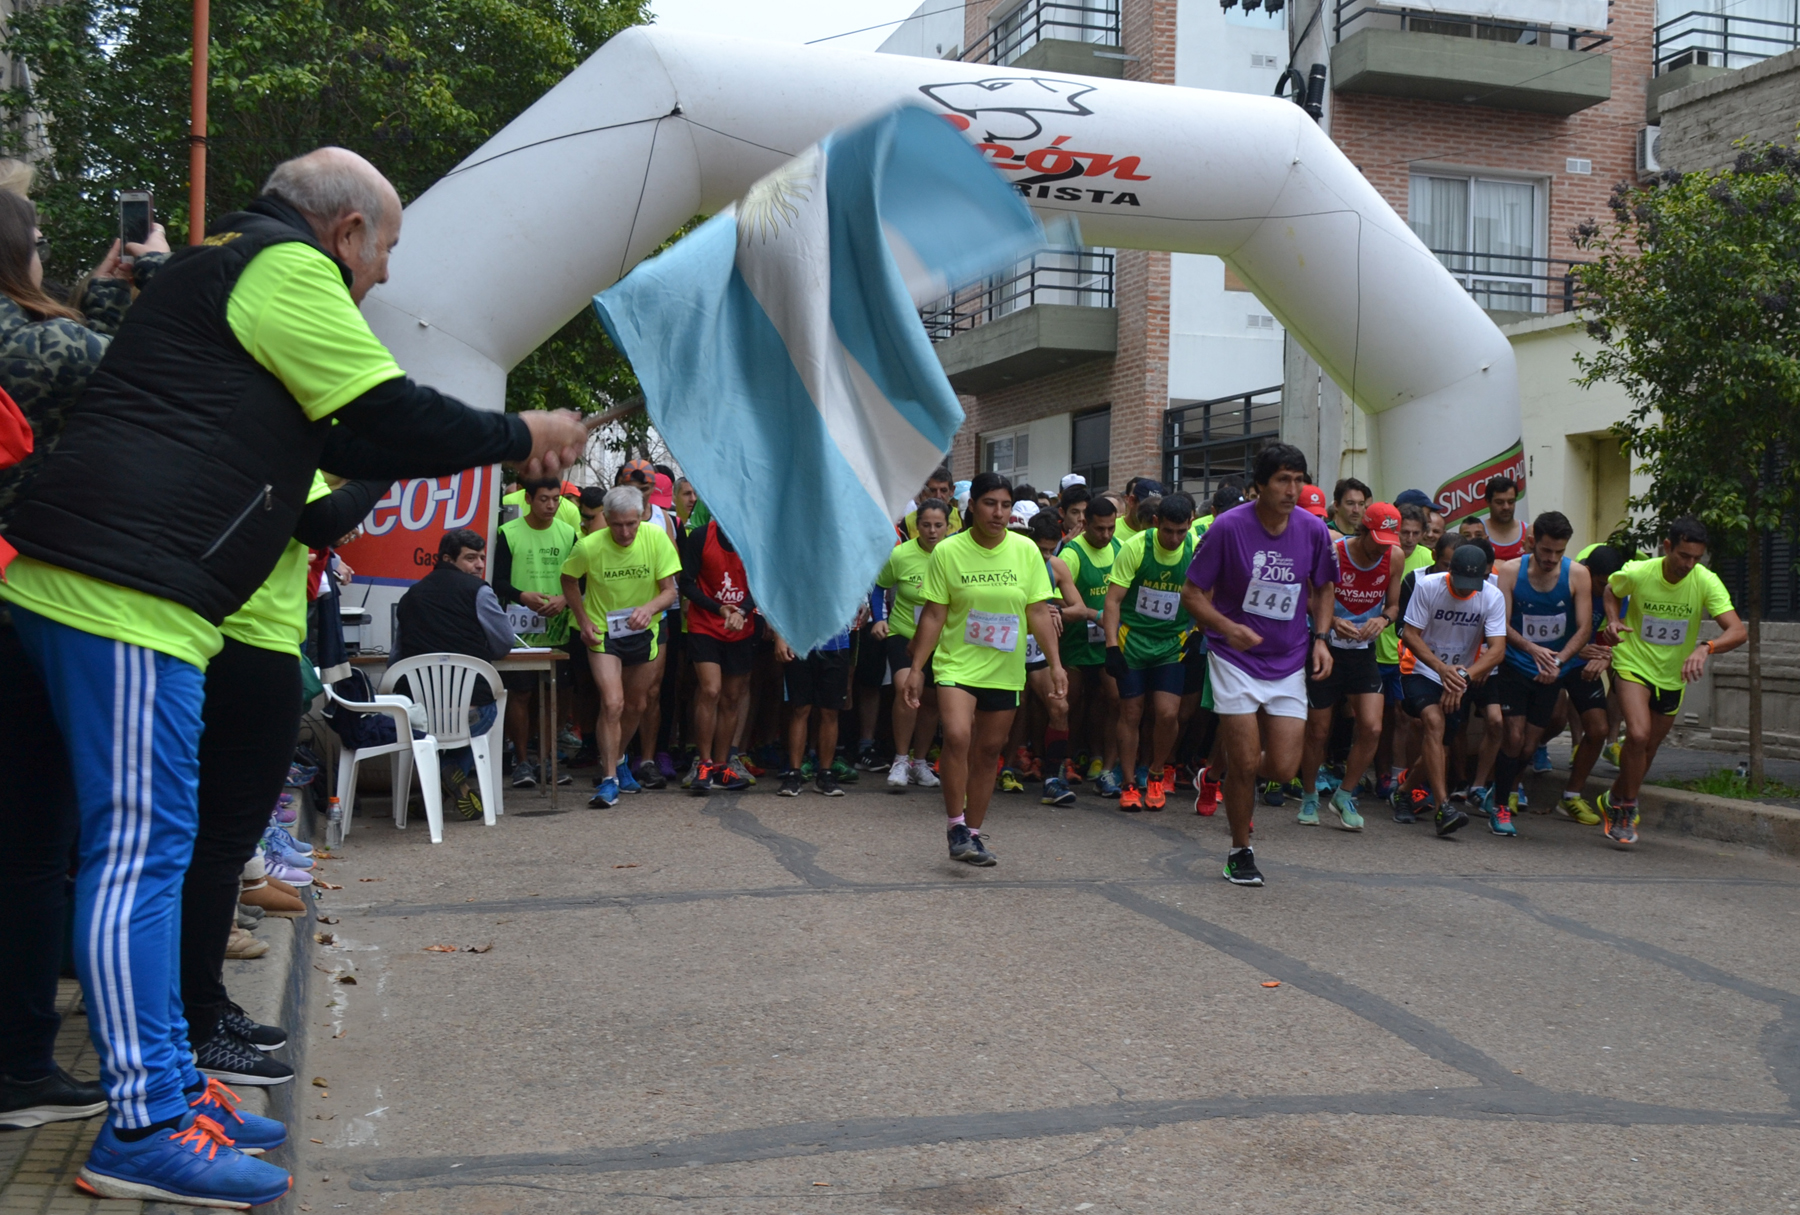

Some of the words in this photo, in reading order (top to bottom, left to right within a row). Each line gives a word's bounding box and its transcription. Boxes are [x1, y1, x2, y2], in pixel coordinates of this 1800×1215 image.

[938, 114, 1151, 181] eón
[1011, 182, 1141, 206] RISTA
[1438, 460, 1526, 518] SINCIDAD
[363, 466, 483, 536] eo-D
[413, 547, 440, 566] Gas
[1261, 565, 1295, 582] 2016
[1248, 590, 1292, 613] 146
[1334, 587, 1385, 599] PAYSANDU
[1140, 596, 1173, 615] 119
[1434, 609, 1481, 624] BOTIJA
[969, 622, 1011, 644] 327
[1527, 623, 1560, 637] 064
[1645, 625, 1680, 641] 123
